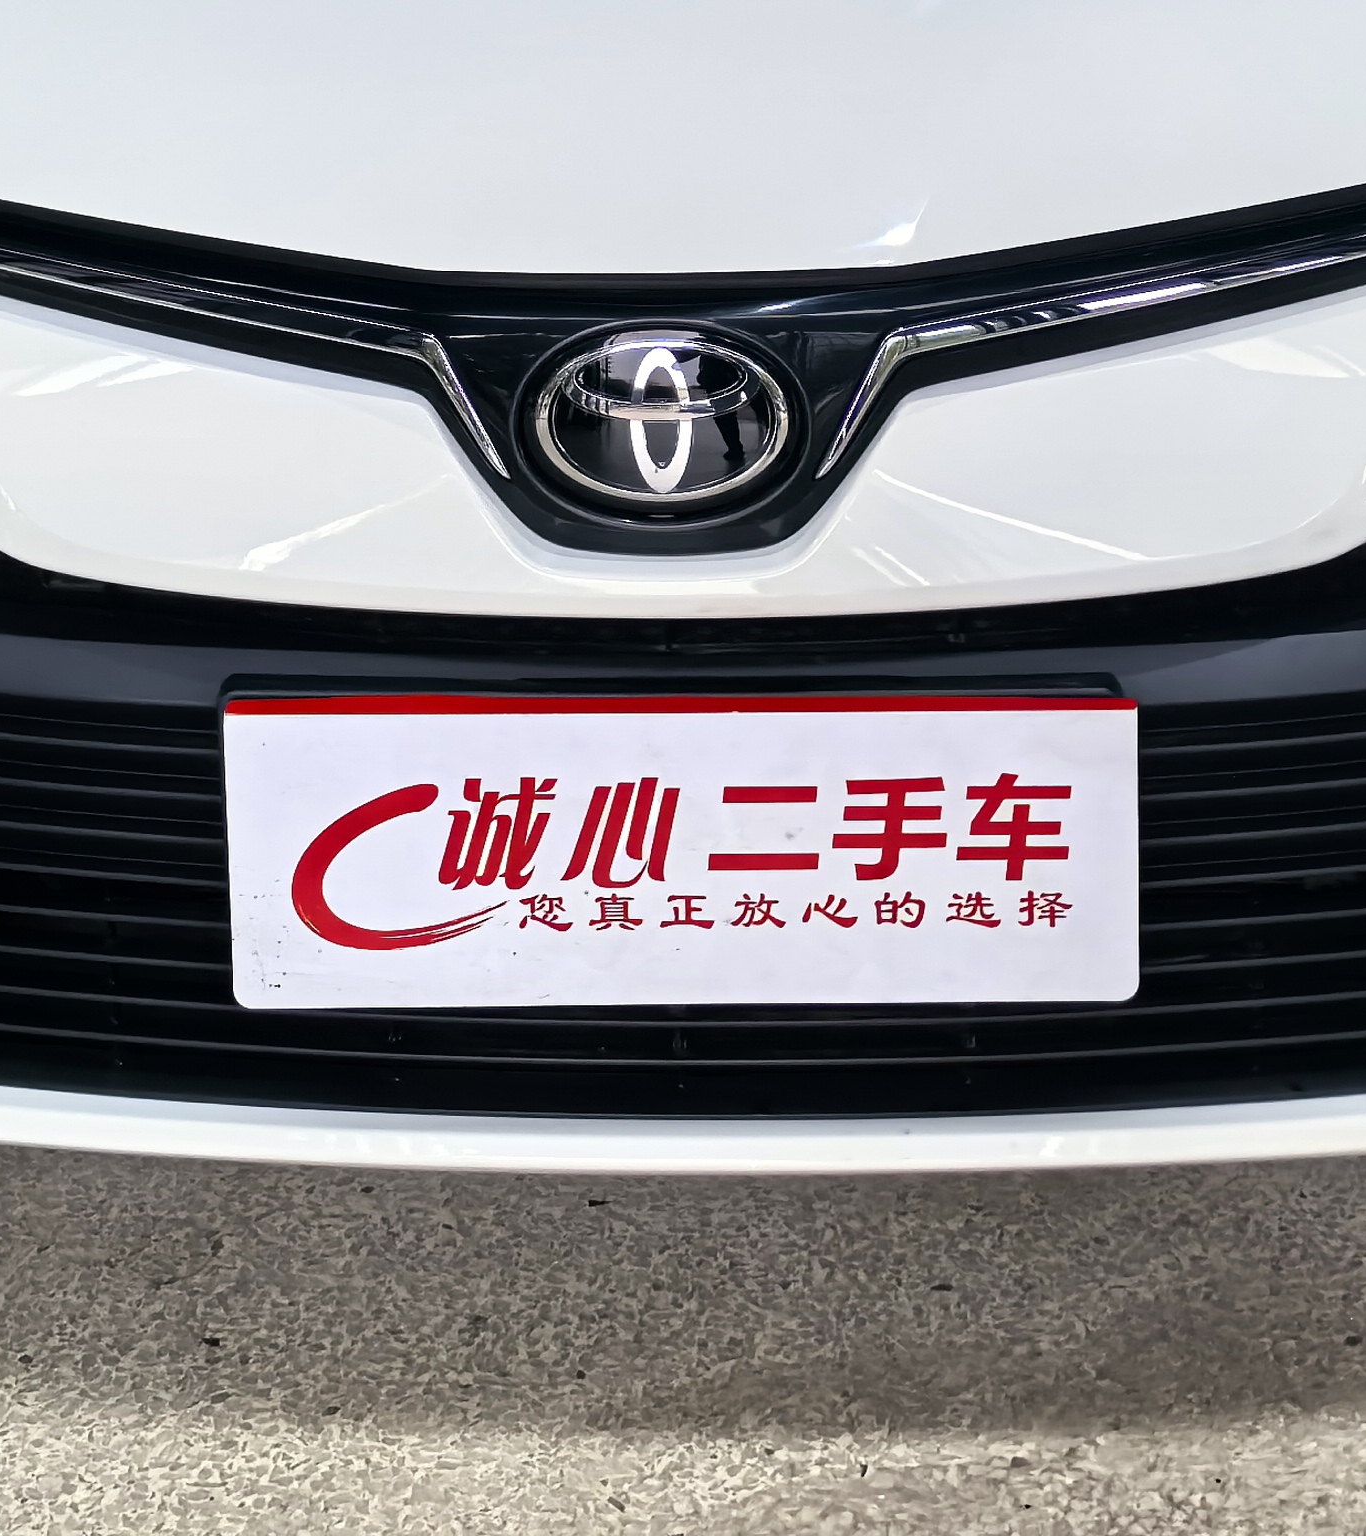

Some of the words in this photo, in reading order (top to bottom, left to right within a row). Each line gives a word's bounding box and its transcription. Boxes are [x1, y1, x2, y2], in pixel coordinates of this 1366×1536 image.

[437, 773, 1073, 891] 诚心二手车
[519, 893, 1073, 932] 您真正放心的选择
